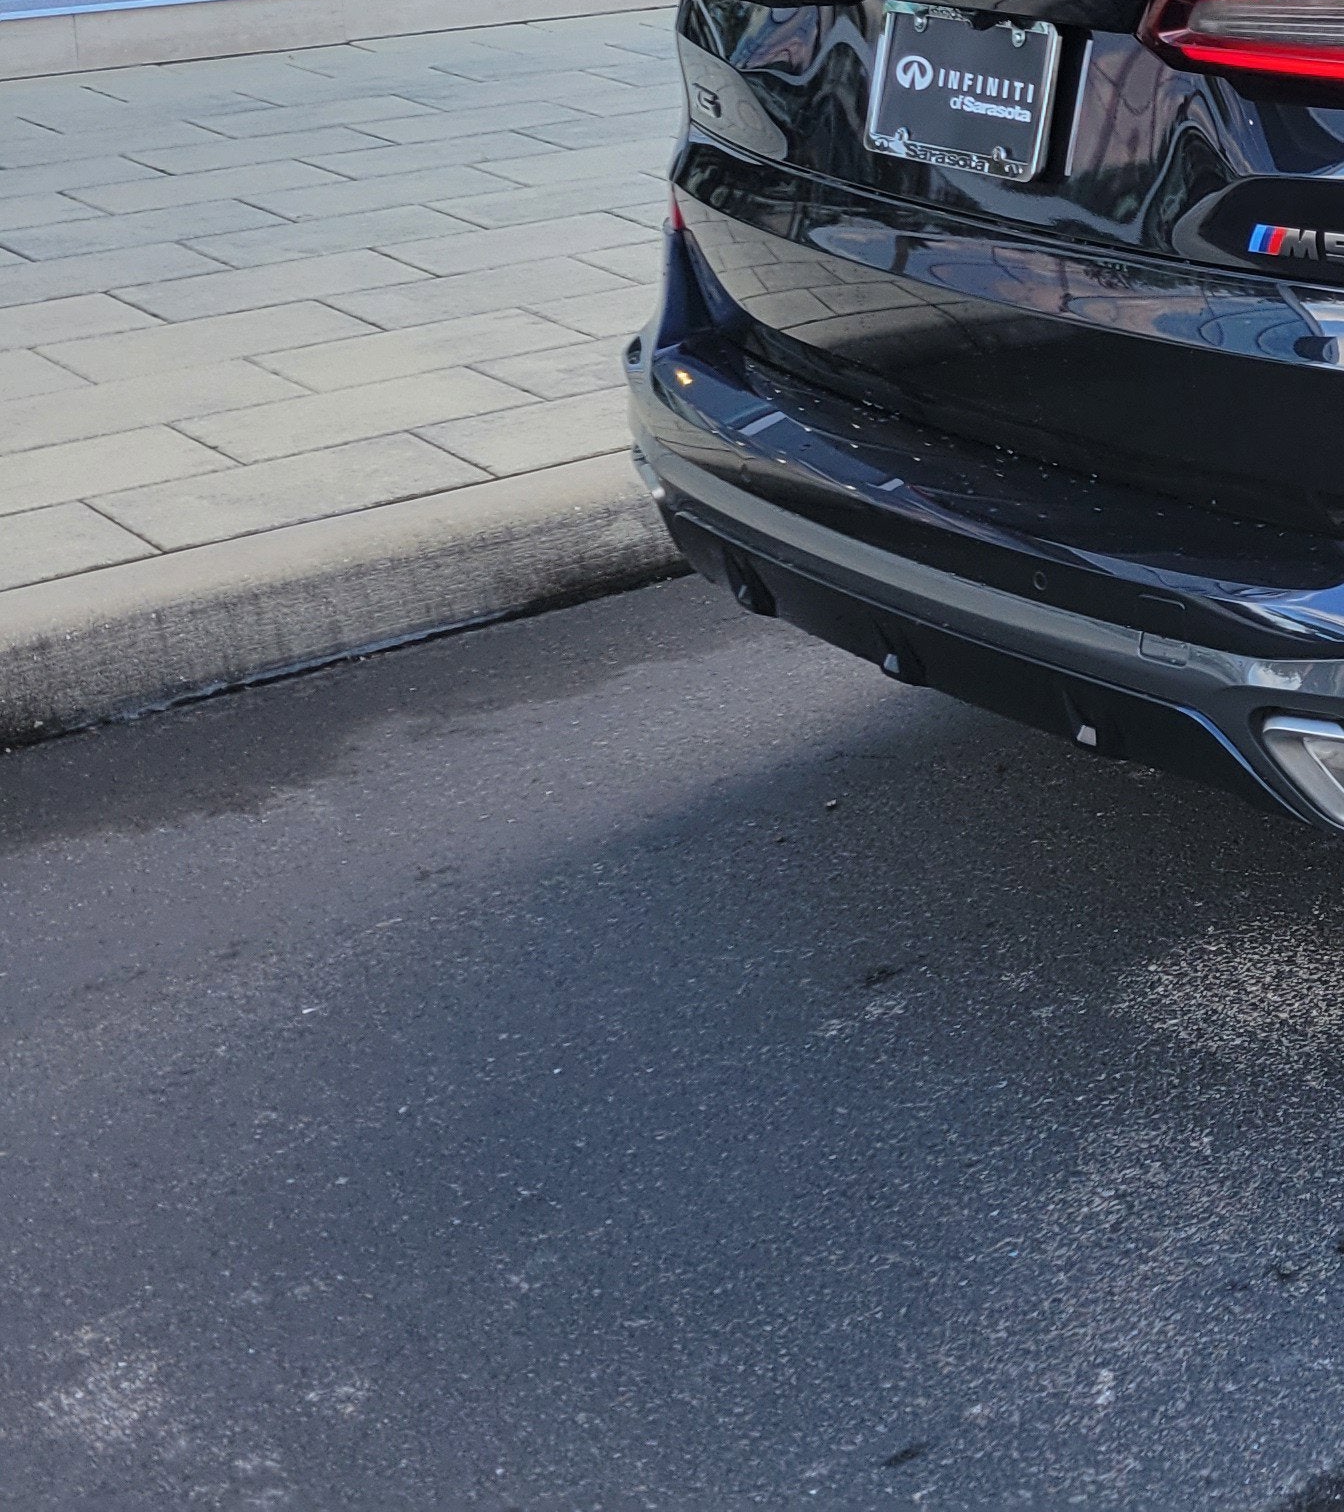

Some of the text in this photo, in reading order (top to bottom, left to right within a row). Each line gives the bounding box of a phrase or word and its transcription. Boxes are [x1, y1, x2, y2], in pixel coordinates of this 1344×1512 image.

[938, 68, 1034, 103] INFINITI
[963, 96, 1031, 123] Sarasota
[905, 143, 990, 173] Sarasota
